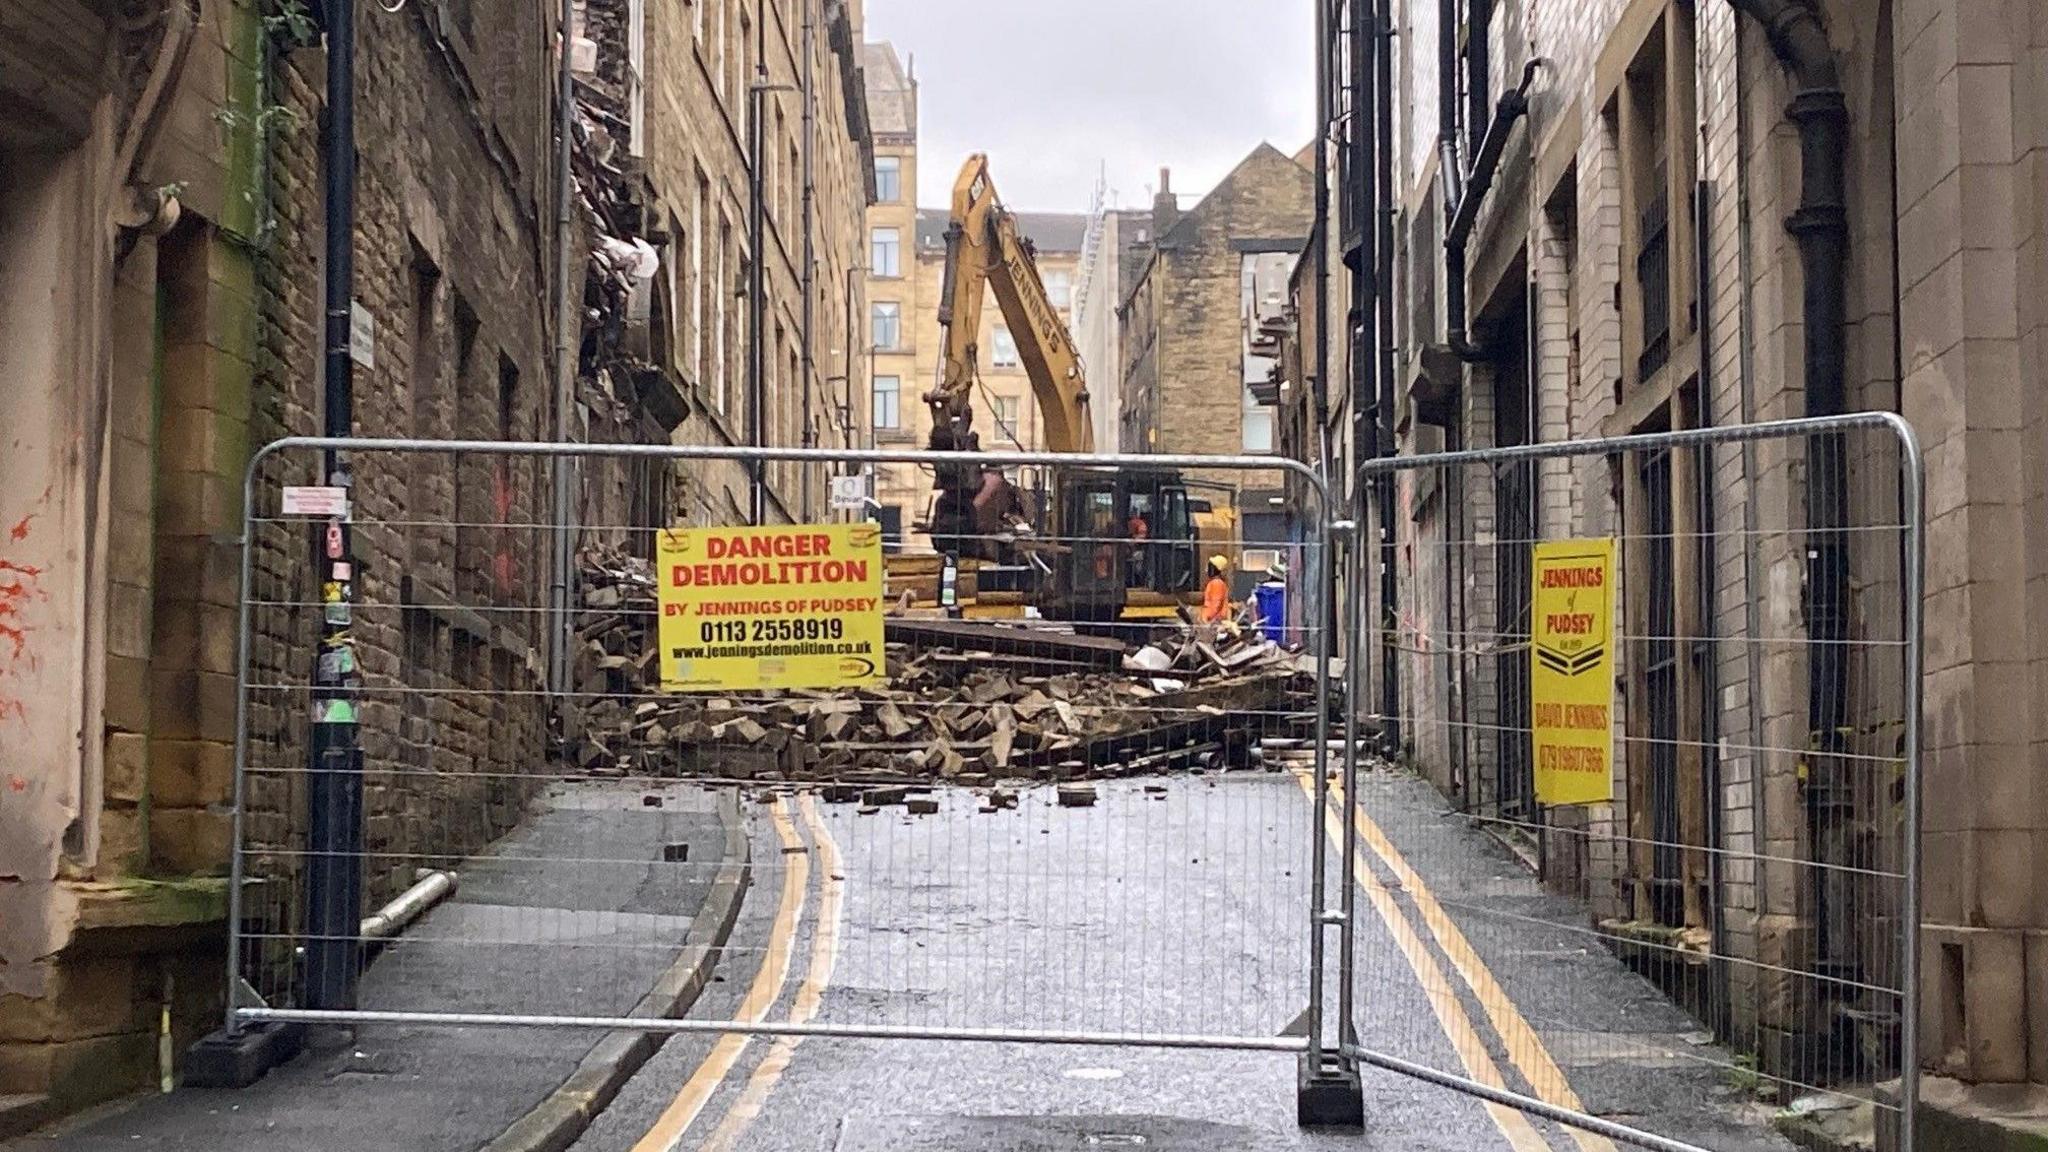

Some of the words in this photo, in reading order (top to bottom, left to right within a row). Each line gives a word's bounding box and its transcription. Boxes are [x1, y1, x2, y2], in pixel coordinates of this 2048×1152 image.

[1008, 256, 1060, 353] JENNINGS
[706, 534, 831, 559] DANGER
[672, 560, 867, 587] DEMOLITION
[1540, 567, 1603, 588] JENNINGS
[664, 603, 688, 617] BY
[695, 600, 782, 616] JENNINGS
[786, 600, 808, 613] OF
[811, 598, 878, 613] PUDSEY
[701, 620, 747, 643] 0113
[752, 618, 843, 641] 2558919
[1546, 613, 1595, 634] PUDSEY
[672, 641, 872, 659] www.jenningsdemolition.co.uk
[1536, 703, 1562, 729] DAVID
[1565, 704, 1607, 731] JENNINGS
